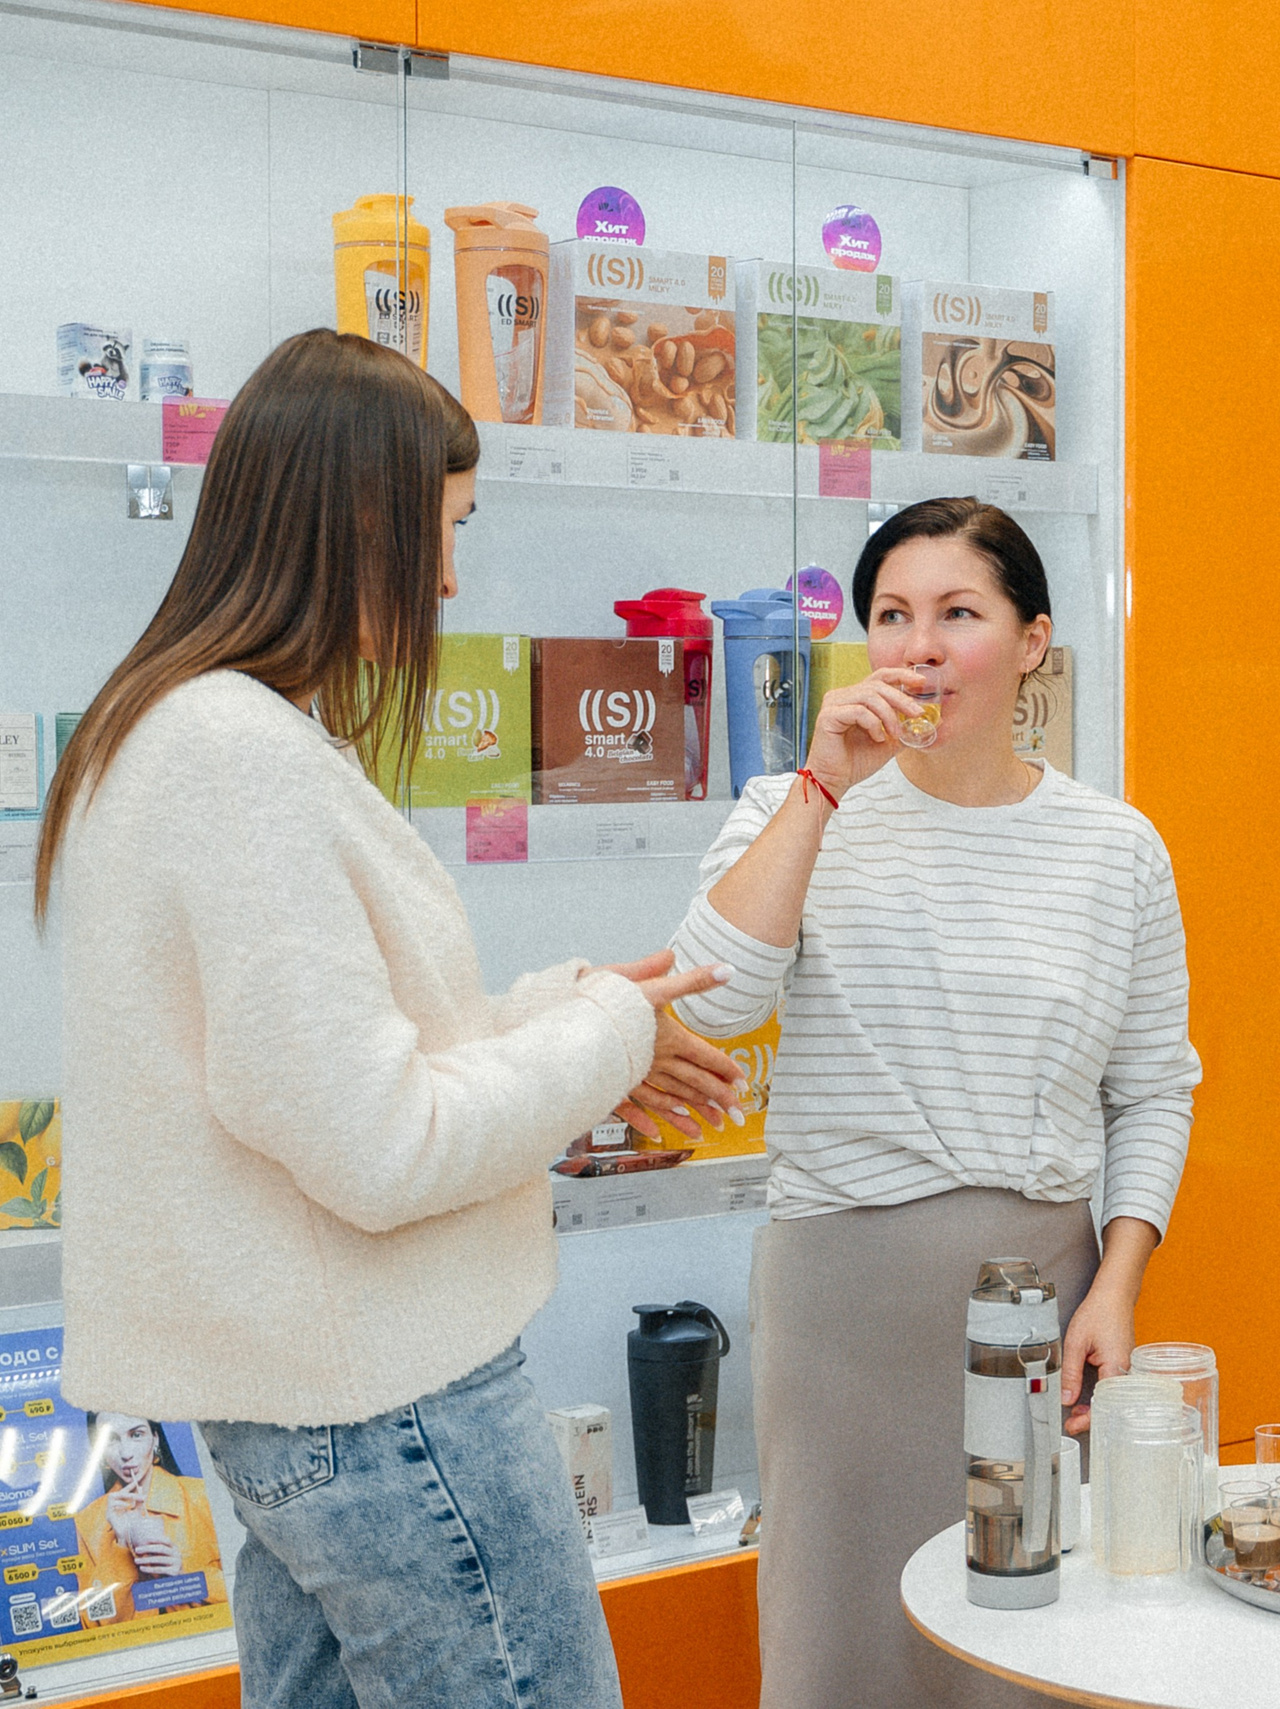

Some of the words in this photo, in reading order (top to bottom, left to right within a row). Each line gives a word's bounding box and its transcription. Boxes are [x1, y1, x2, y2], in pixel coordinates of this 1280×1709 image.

[594, 220, 629, 234] Хит
[840, 235, 869, 250] Хит
[831, 247, 876, 261] продаж
[711, 266, 724, 278] 20
[879, 284, 890, 295] 20
[1035, 303, 1047, 313] 20
[501, 318, 512, 326] ED
[514, 319, 537, 327] SMART
[87, 375, 117, 389] HAPPY
[158, 376, 182, 388] HAPPY
[97, 384, 125, 400] SMILE
[802, 596, 831, 609] Хит
[801, 611, 837, 620] родаж
[661, 644, 672, 653] 20
[425, 733, 468, 746] smart
[585, 733, 626, 745] smart
[425, 748, 445, 759] 4.0
[585, 747, 605, 758] 4.0
[608, 749, 635, 759] Belgian
[620, 753, 653, 763] chocolate
[39, 1538, 59, 1549] Set
[62, 1564, 77, 1572] 350
[54, 1636, 97, 1649] выбранный
